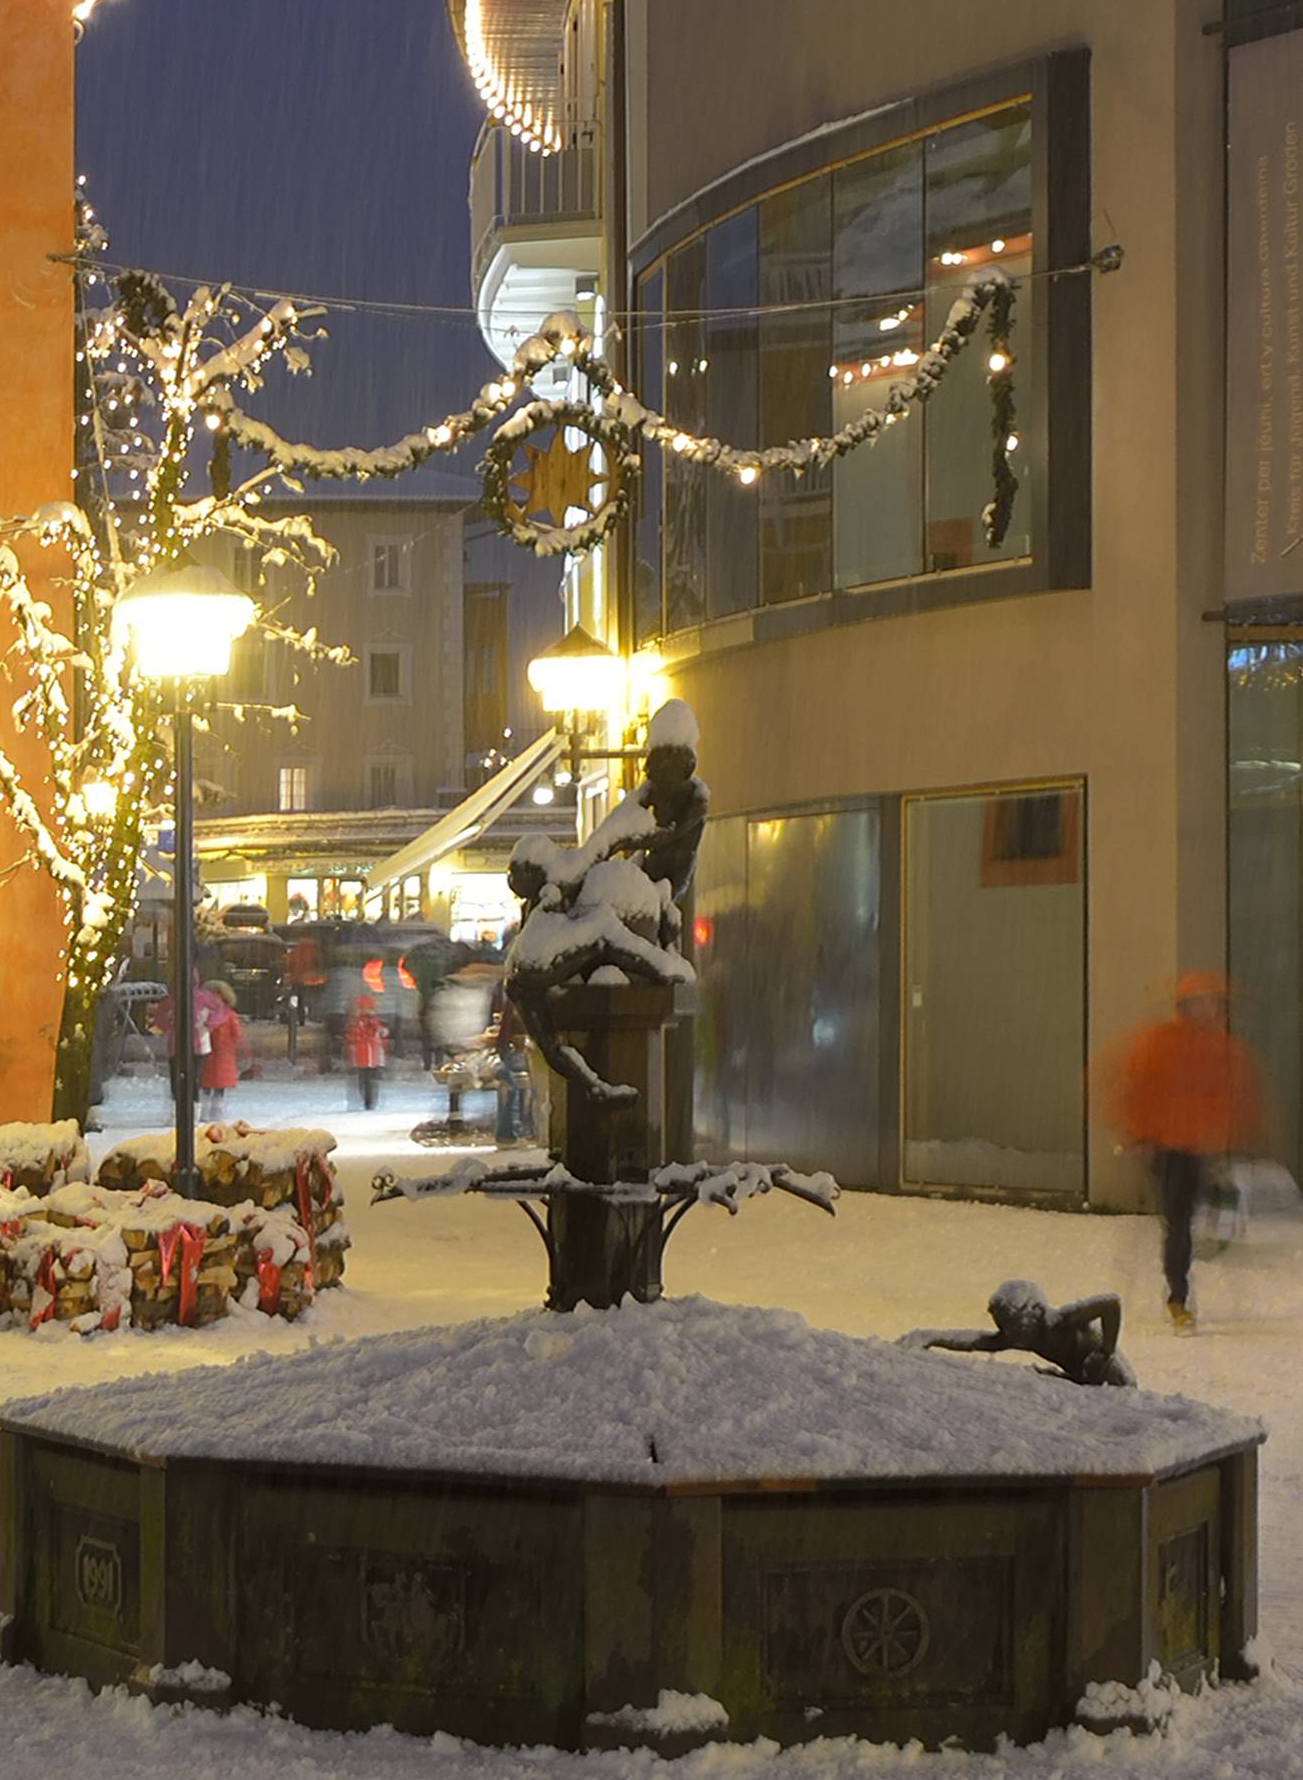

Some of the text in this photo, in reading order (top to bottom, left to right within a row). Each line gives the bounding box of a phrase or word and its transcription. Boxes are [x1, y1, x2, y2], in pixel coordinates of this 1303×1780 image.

[1283, 201, 1299, 258] Kultur
[1258, 268, 1272, 339] cultura
[1285, 264, 1300, 300] und
[1284, 308, 1300, 364] Kunst
[1258, 460, 1273, 491] per
[1250, 500, 1270, 565] Zenter
[83, 1554, 114, 1602] 1991
